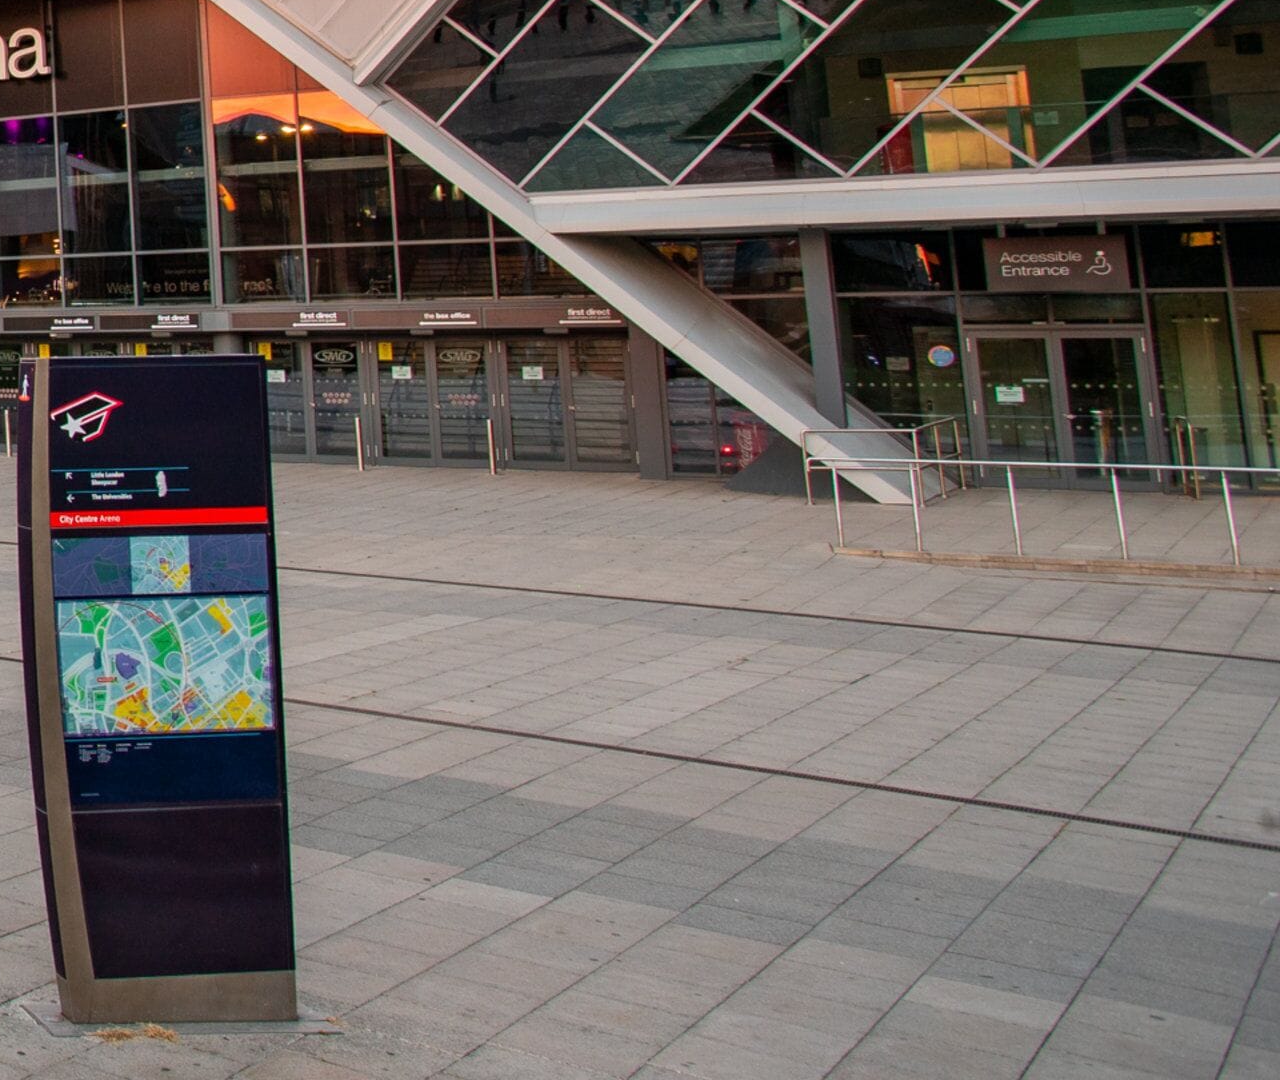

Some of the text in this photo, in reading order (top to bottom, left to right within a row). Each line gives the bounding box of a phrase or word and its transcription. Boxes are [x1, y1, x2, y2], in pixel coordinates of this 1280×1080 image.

[999, 251, 1082, 263] Accessible
[1001, 265, 1070, 277] Entrance
[164, 281, 177, 293] to
[180, 280, 200, 293] the
[321, 350, 347, 361] SMG
[446, 350, 473, 361] SMG
[59, 515, 73, 525] City
[75, 514, 98, 523] Centre
